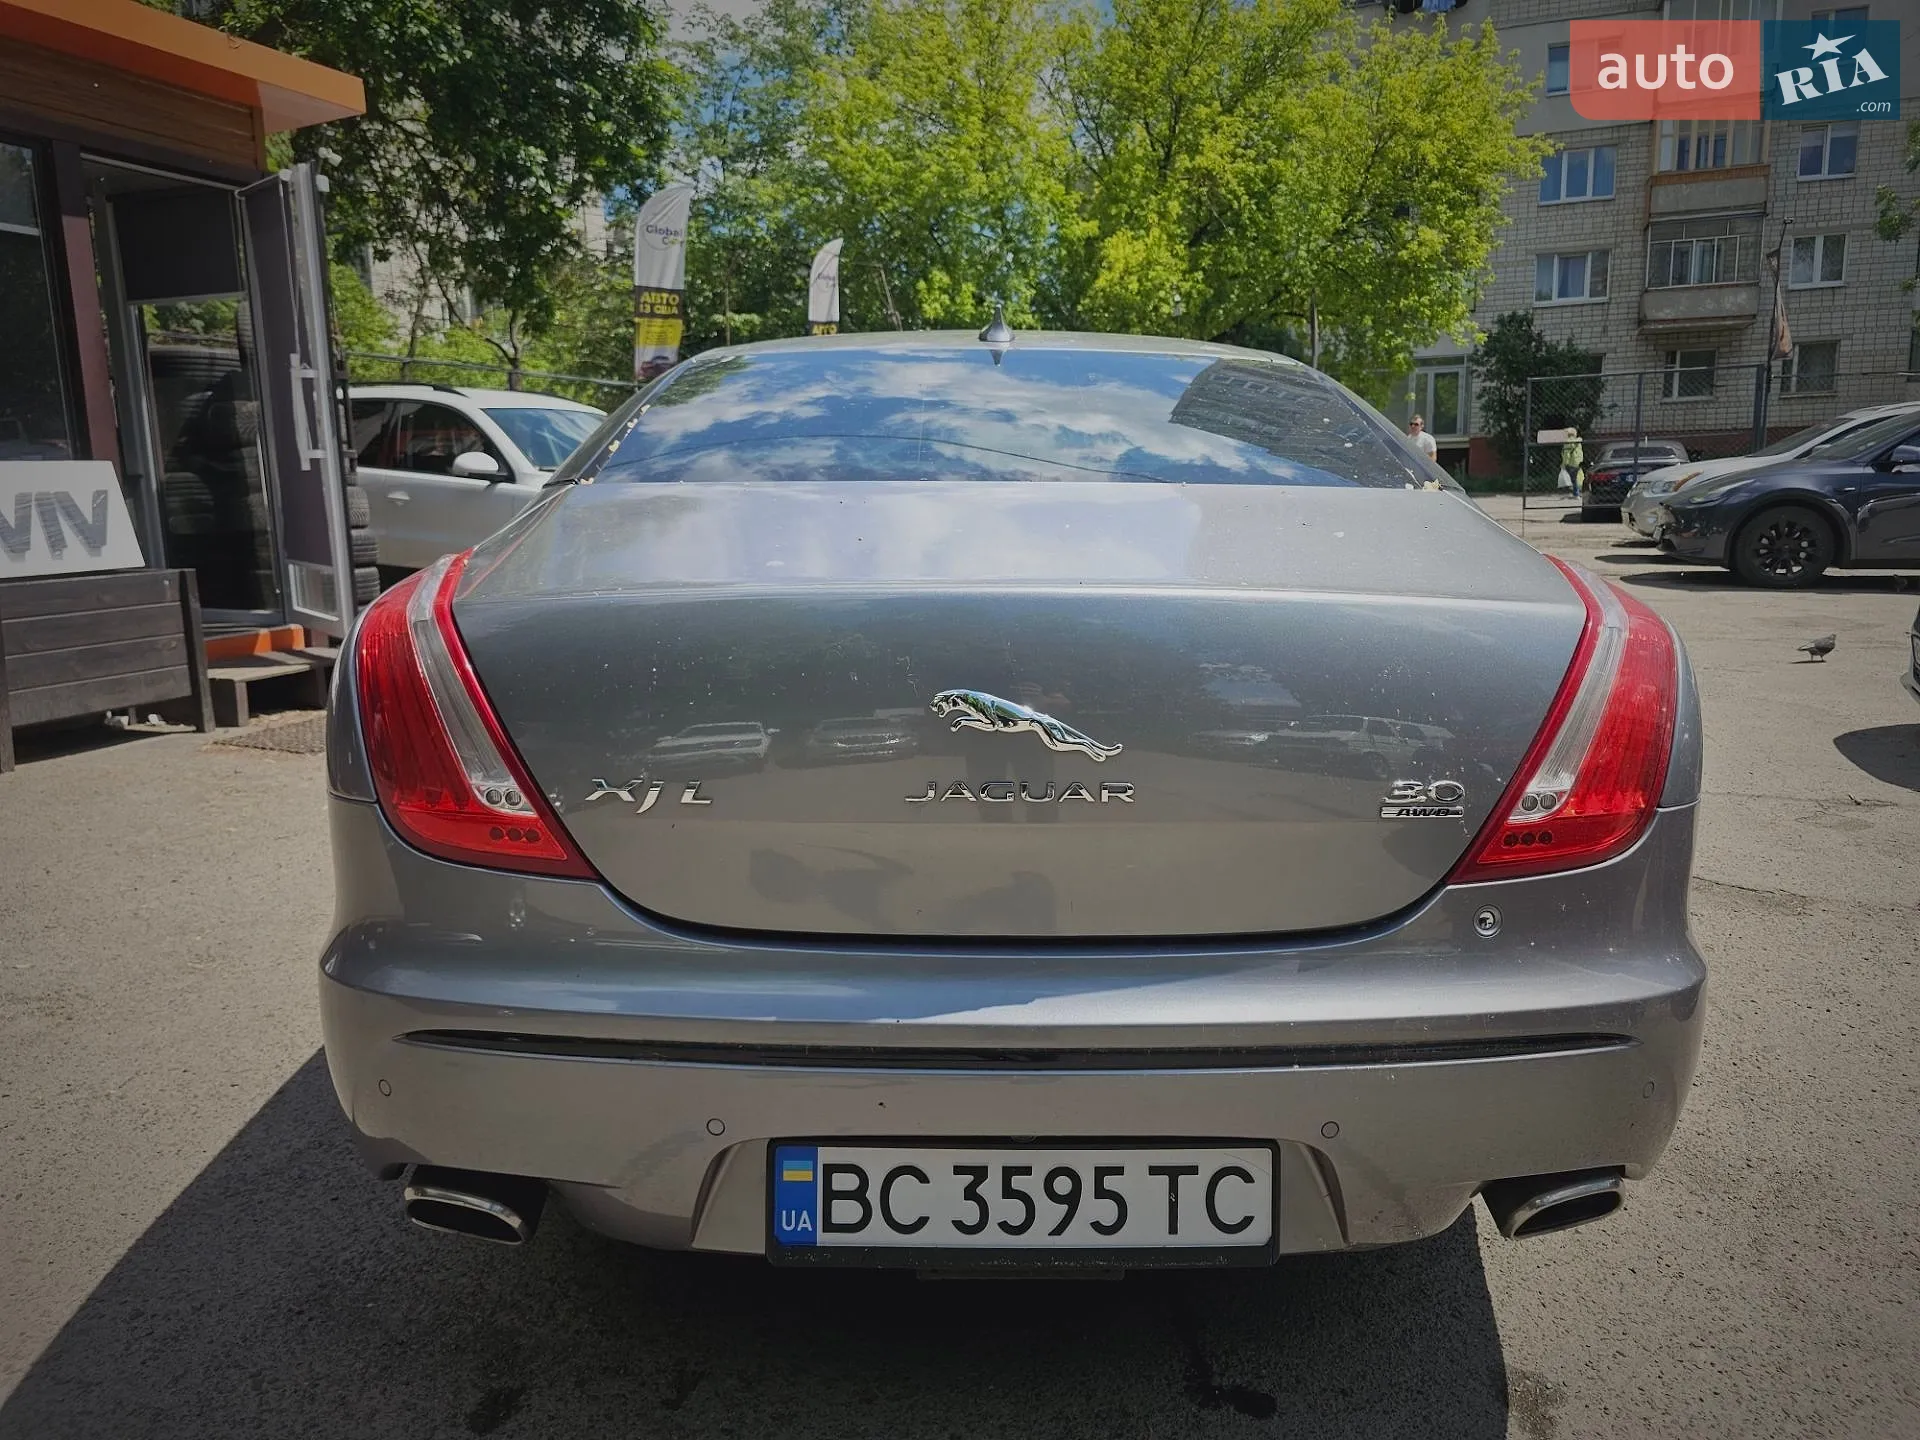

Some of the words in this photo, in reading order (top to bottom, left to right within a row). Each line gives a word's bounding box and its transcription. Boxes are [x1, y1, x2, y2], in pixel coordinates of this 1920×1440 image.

[646, 224, 683, 237] Global
[641, 291, 680, 305] АВТО
[904, 780, 1136, 803] JAGUAR
[1393, 807, 1453, 818] AWD
[822, 1163, 931, 1236] BC
[951, 1164, 1128, 1237] 3595
[1148, 1164, 1256, 1236] TC
[781, 1209, 813, 1232] UA
